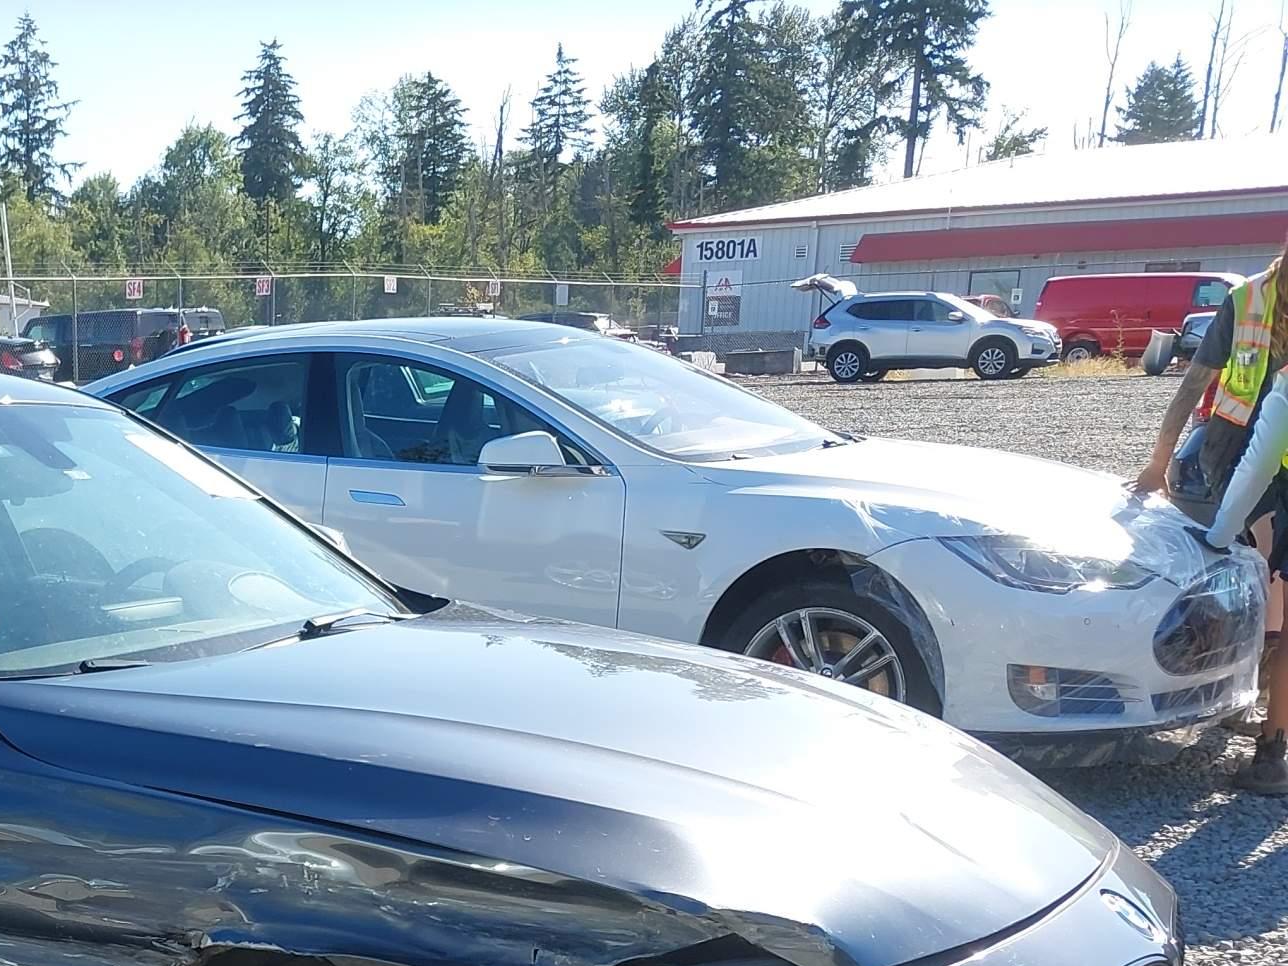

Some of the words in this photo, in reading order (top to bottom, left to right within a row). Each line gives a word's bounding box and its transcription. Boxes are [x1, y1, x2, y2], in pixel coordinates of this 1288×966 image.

[696, 238, 758, 261] 15801A
[127, 281, 142, 297] SF4
[257, 279, 270, 294] SF3
